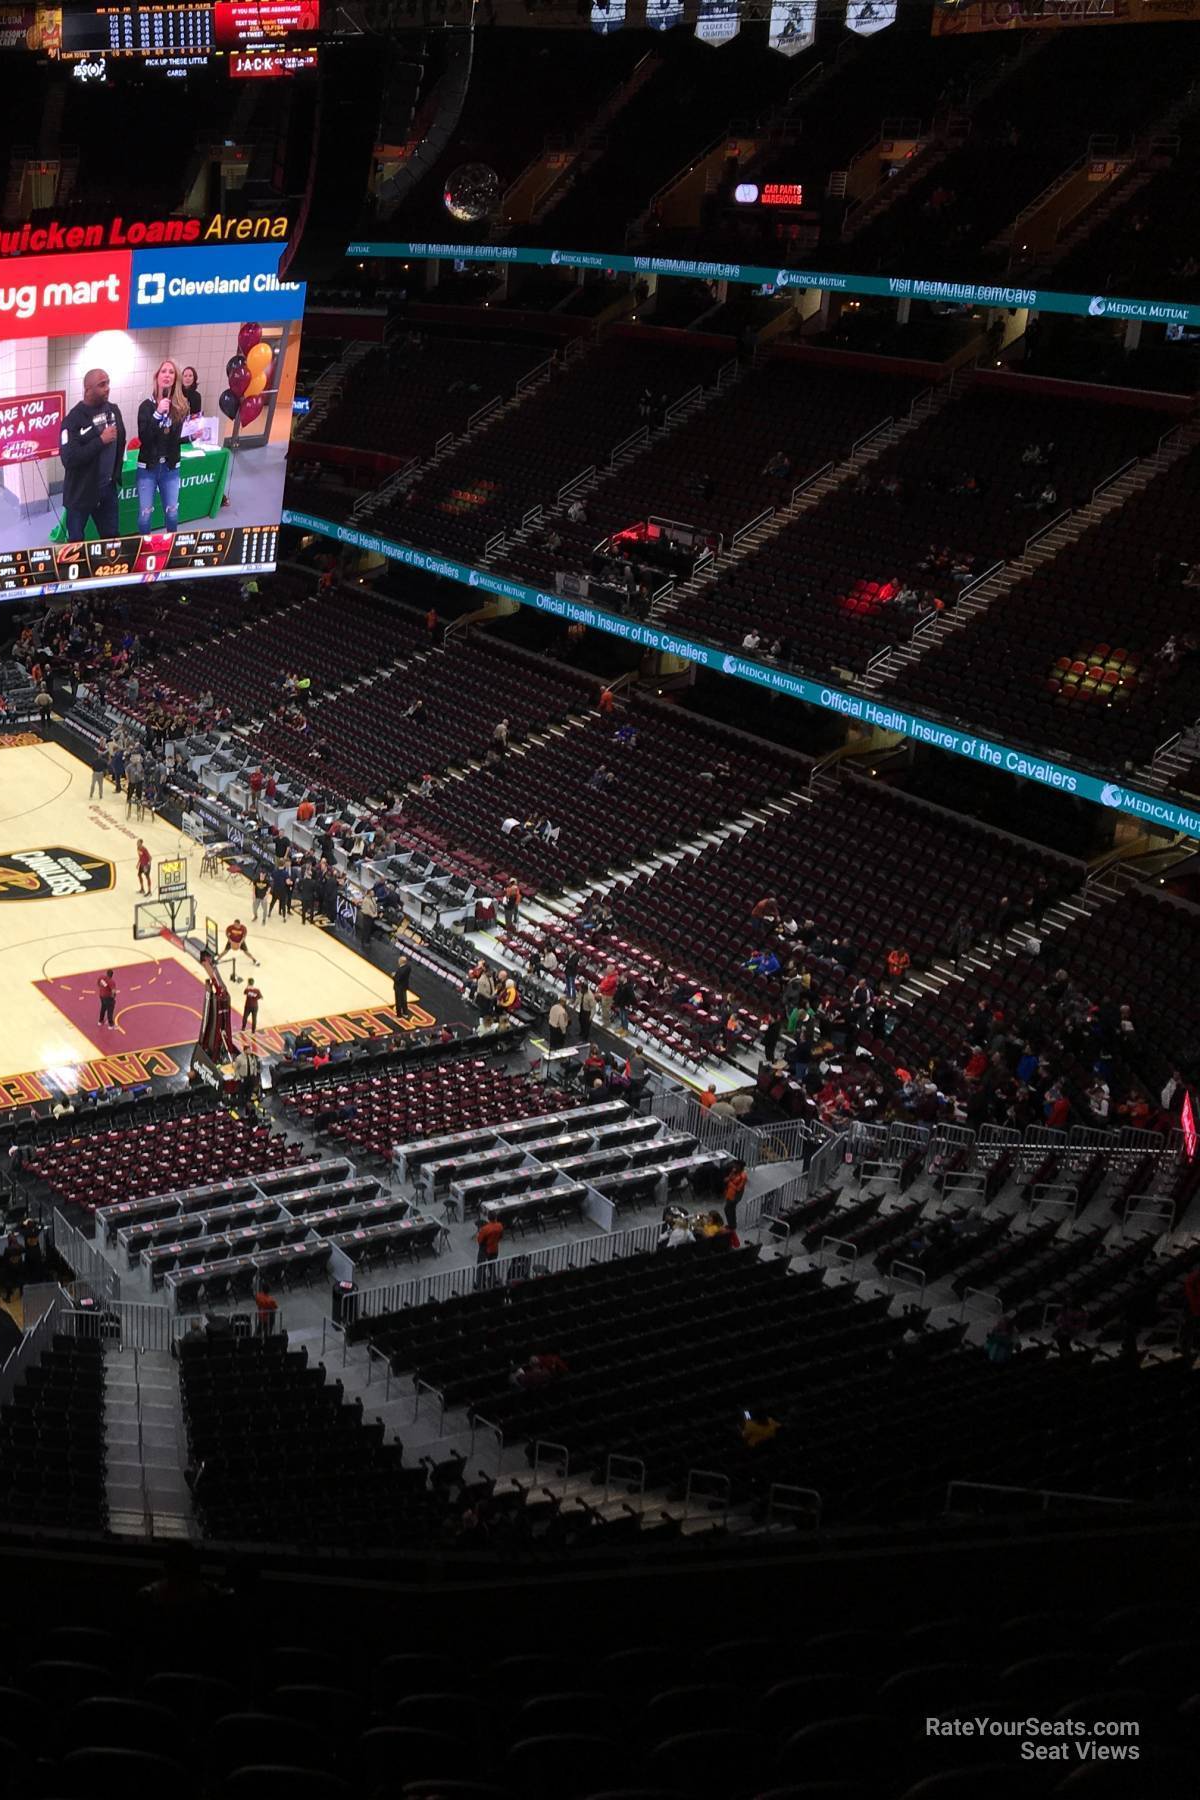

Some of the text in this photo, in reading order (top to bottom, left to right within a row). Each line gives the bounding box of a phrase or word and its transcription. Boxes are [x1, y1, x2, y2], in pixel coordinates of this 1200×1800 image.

[188, 57, 208, 65] LITTLE
[167, 69, 187, 77] CARDS
[765, 184, 802, 194] CAR PARTS
[761, 194, 802, 205] WAREHOUSE
[109, 217, 200, 246] Loans
[204, 213, 289, 241] Arena
[168, 275, 249, 297] Cleveland
[787, 273, 847, 288] MEDICAL MUTUAL
[43, 273, 120, 307] mart
[1106, 302, 1189, 320] MEDICAL MUTUAL
[20, 400, 44, 418] YOU
[0, 423, 15, 440] AS
[16, 420, 26, 436] A
[28, 411, 60, 431] PRO?
[9, 446, 34, 457] PRO
[177, 472, 216, 487] UTUAL
[220, 531, 226, 539] 0
[91, 544, 102, 555] 1Q
[110, 549, 115, 557] 0
[180, 546, 187, 555] 0
[217, 544, 223, 552] 0
[337, 526, 459, 579] Official Health Insurer of the Cavaliers
[16, 553, 22, 561] 0
[146, 555, 156, 571] 0
[19, 565, 25, 573] 0
[39, 563, 45, 571] 0
[69, 564, 79, 580] 0
[95, 564, 129, 576] 42:22
[479, 577, 526, 600] MEDICAL MUTUAL
[536, 593, 708, 664] Official Health Insurer of the Cavaliers
[737, 662, 806, 695] MEDICAL MUTUAL
[820, 688, 1078, 792] Official Health Insurer of the Cavaliers
[1123, 793, 1175, 823] MEDICAL
[11, 850, 87, 896] CAVALIERS
